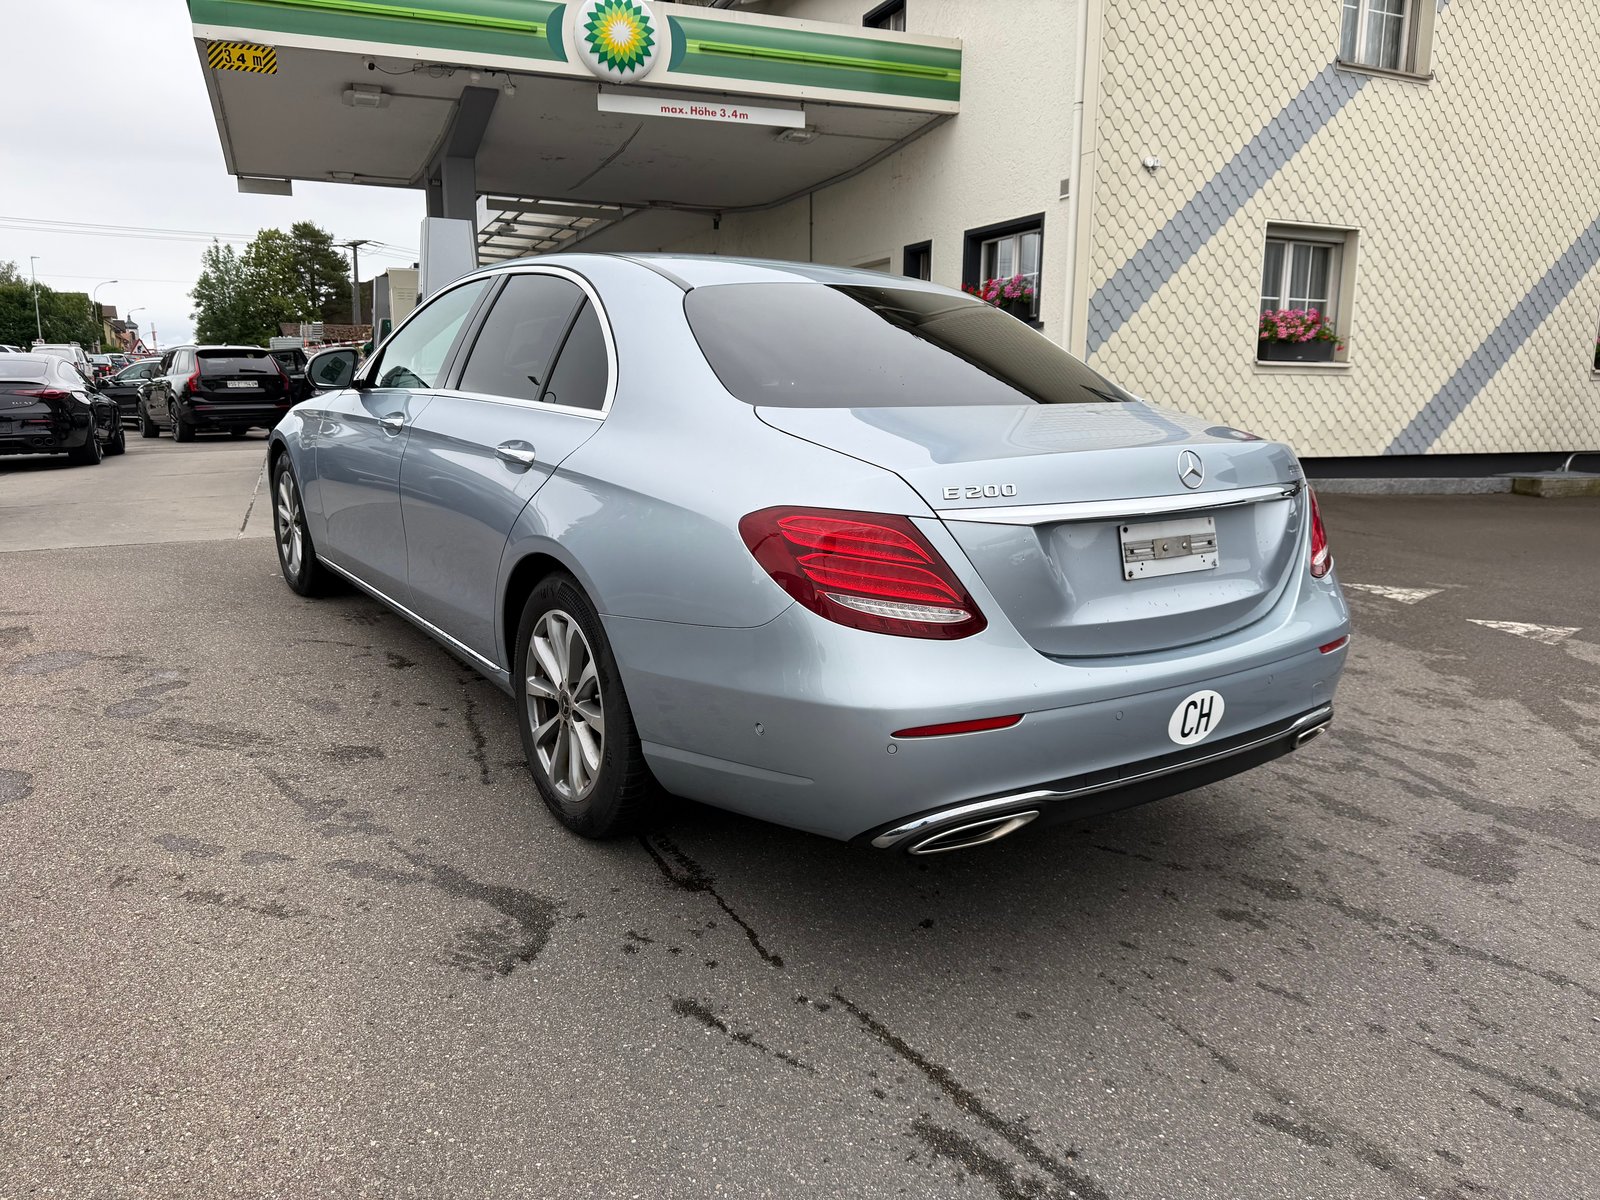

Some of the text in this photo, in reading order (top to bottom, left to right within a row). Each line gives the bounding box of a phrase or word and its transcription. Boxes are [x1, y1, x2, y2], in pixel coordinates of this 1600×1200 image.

[224, 49, 263, 67] 3.4 m
[660, 106, 688, 115] max.
[690, 106, 717, 117] Höhe
[942, 483, 1017, 500] E 200
[1180, 696, 1214, 738] CH
